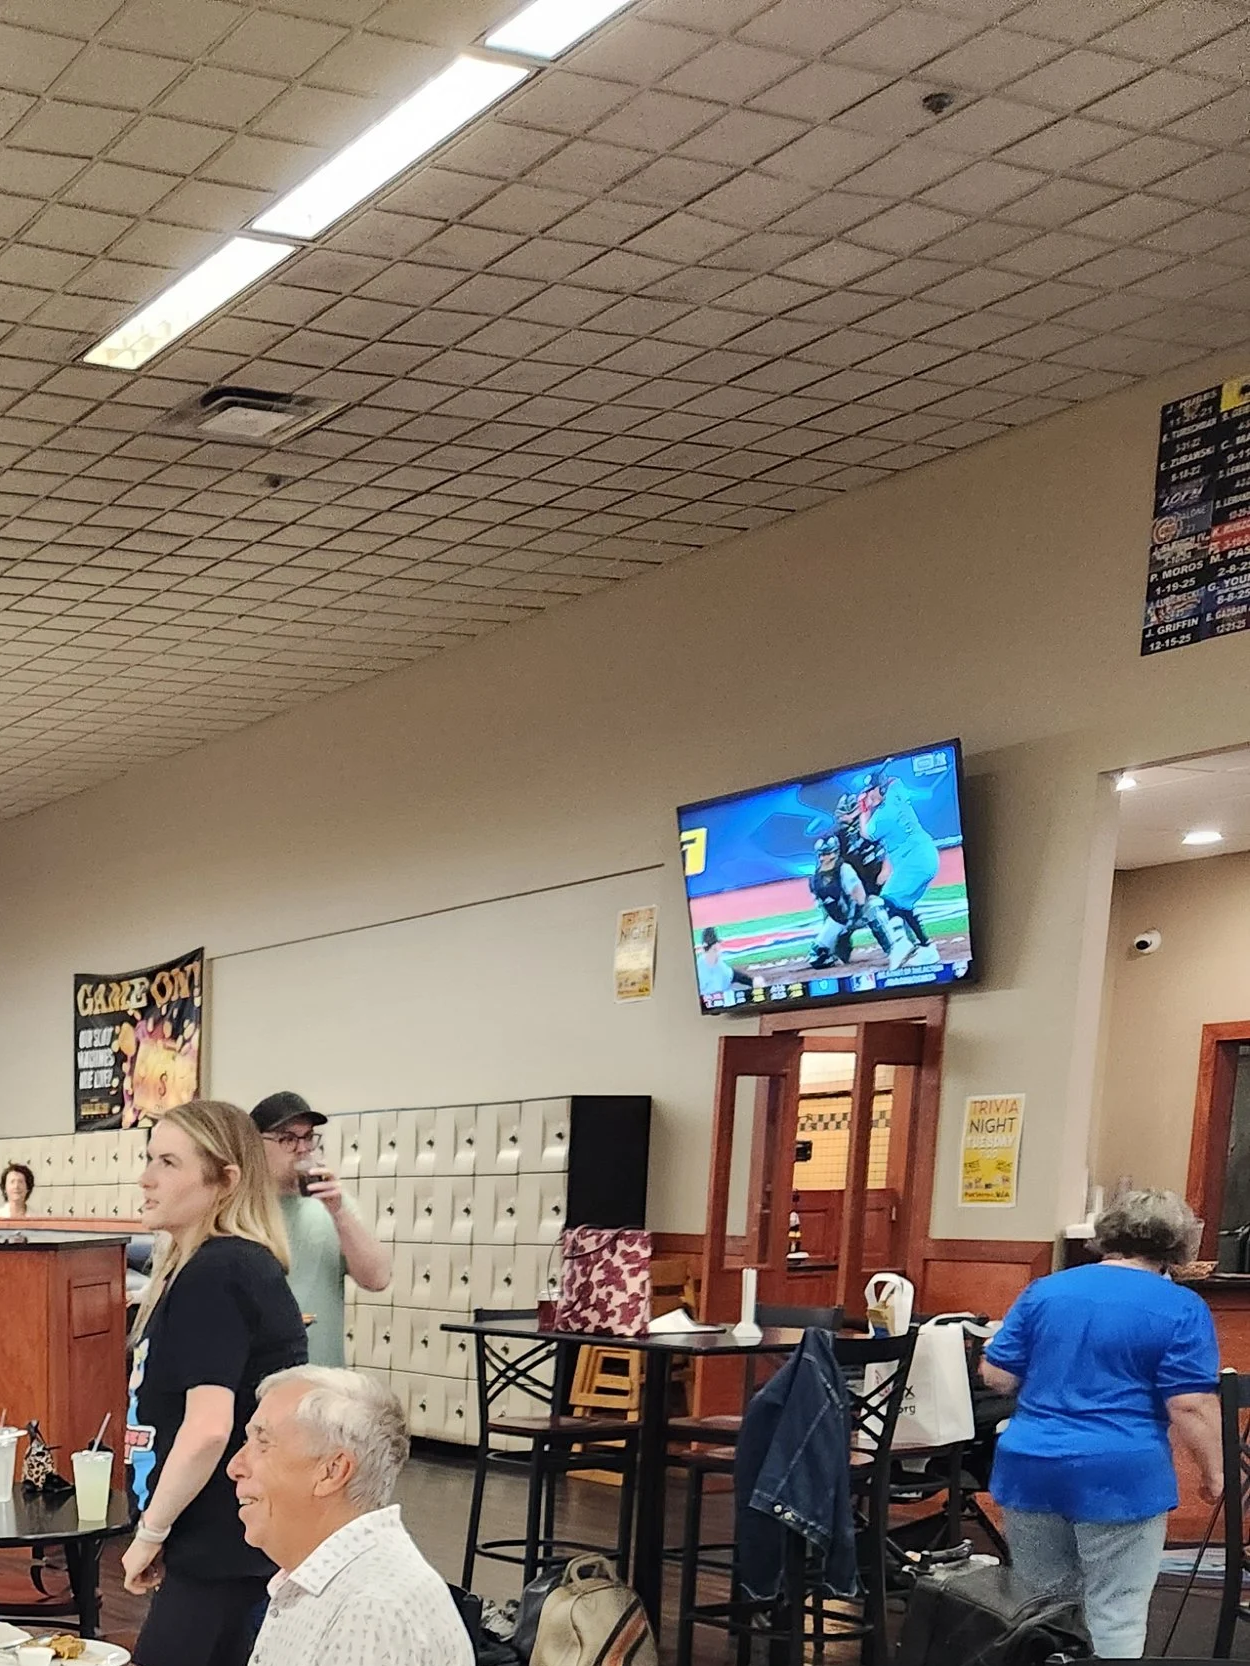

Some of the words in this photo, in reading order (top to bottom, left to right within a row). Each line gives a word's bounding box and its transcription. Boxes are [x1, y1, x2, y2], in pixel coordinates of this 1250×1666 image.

[1150, 573, 1159, 583] P.
[1162, 560, 1204, 580] MOROS
[1155, 577, 1196, 595] 1-19-25
[1156, 617, 1199, 635] GRIFFIN
[1149, 633, 1192, 651] 12-15-25
[77, 977, 150, 1016] GAME
[971, 1099, 1019, 1117] TRIVIA
[970, 1117, 1017, 1134] NIGHT
